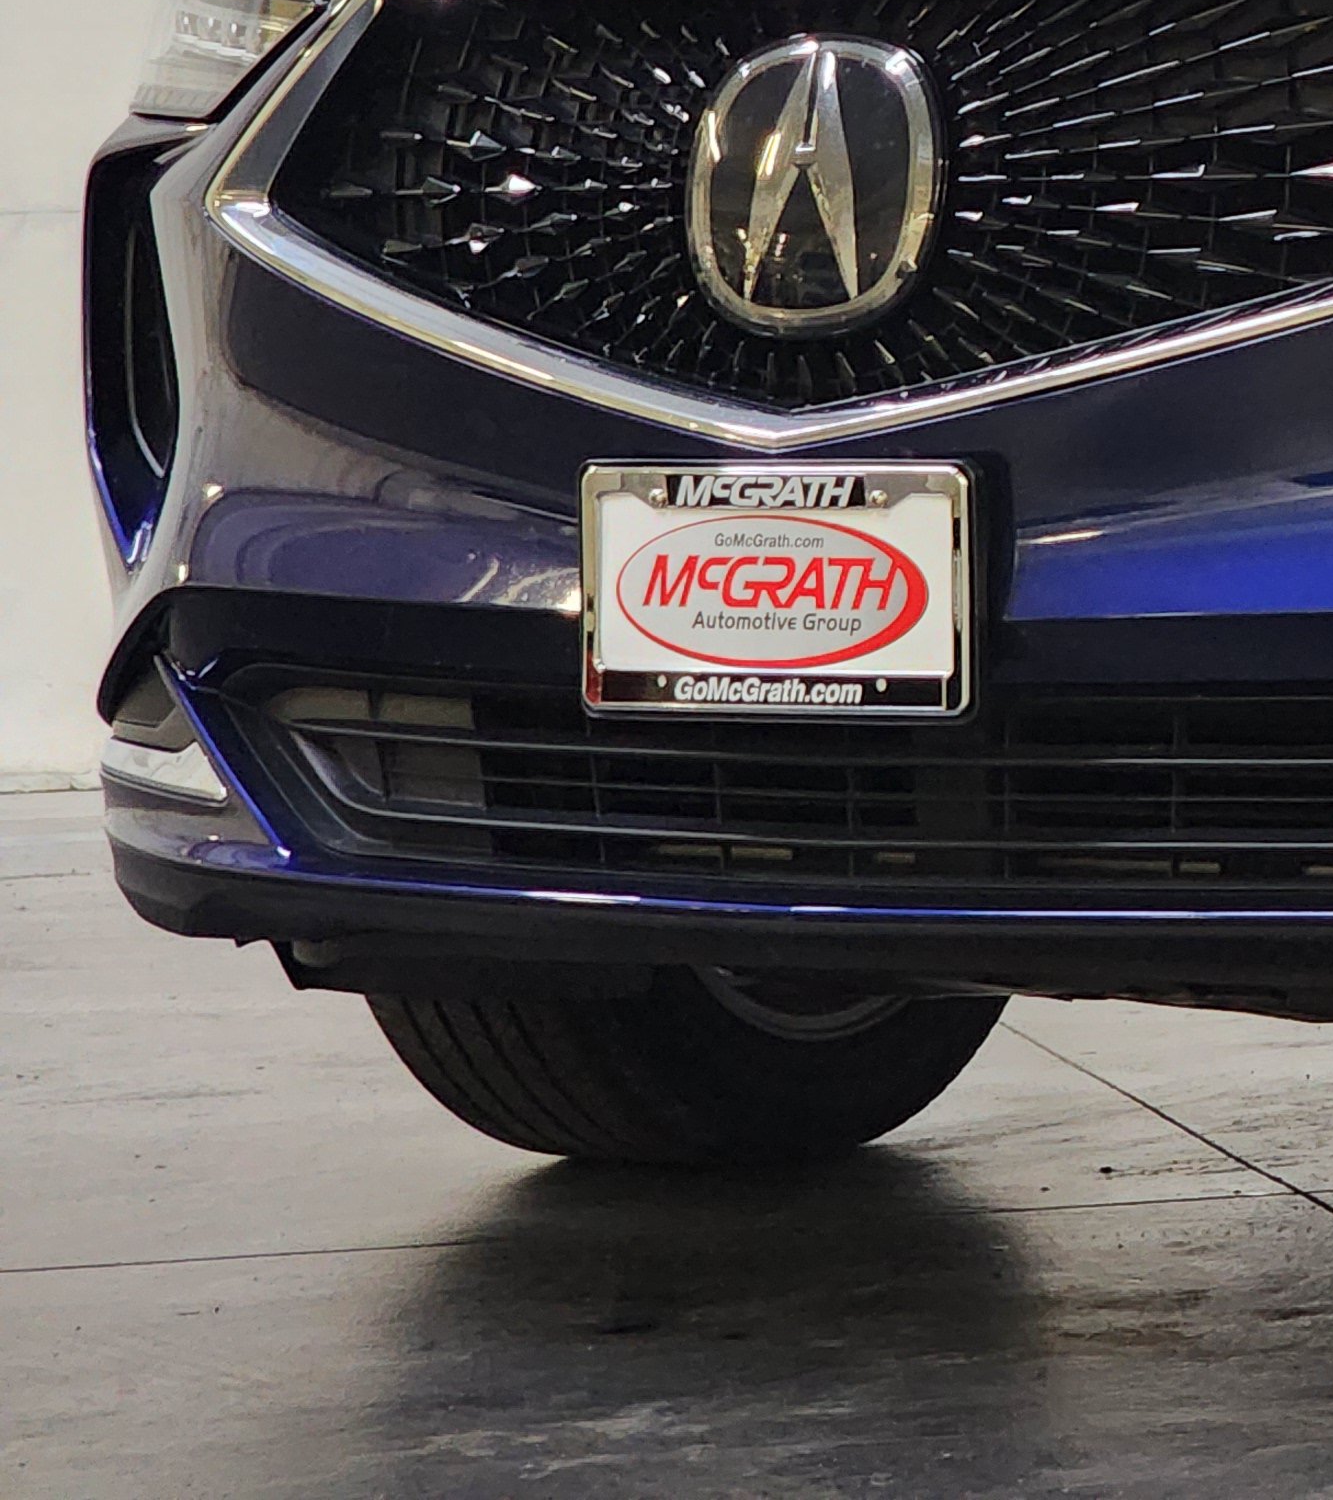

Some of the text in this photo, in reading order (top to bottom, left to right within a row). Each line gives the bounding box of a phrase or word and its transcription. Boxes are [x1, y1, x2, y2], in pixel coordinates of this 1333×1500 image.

[714, 532, 824, 549] GoMcGrath.com
[692, 612, 862, 636] Automotive Group
[674, 676, 863, 704] GoMcGrath.com
